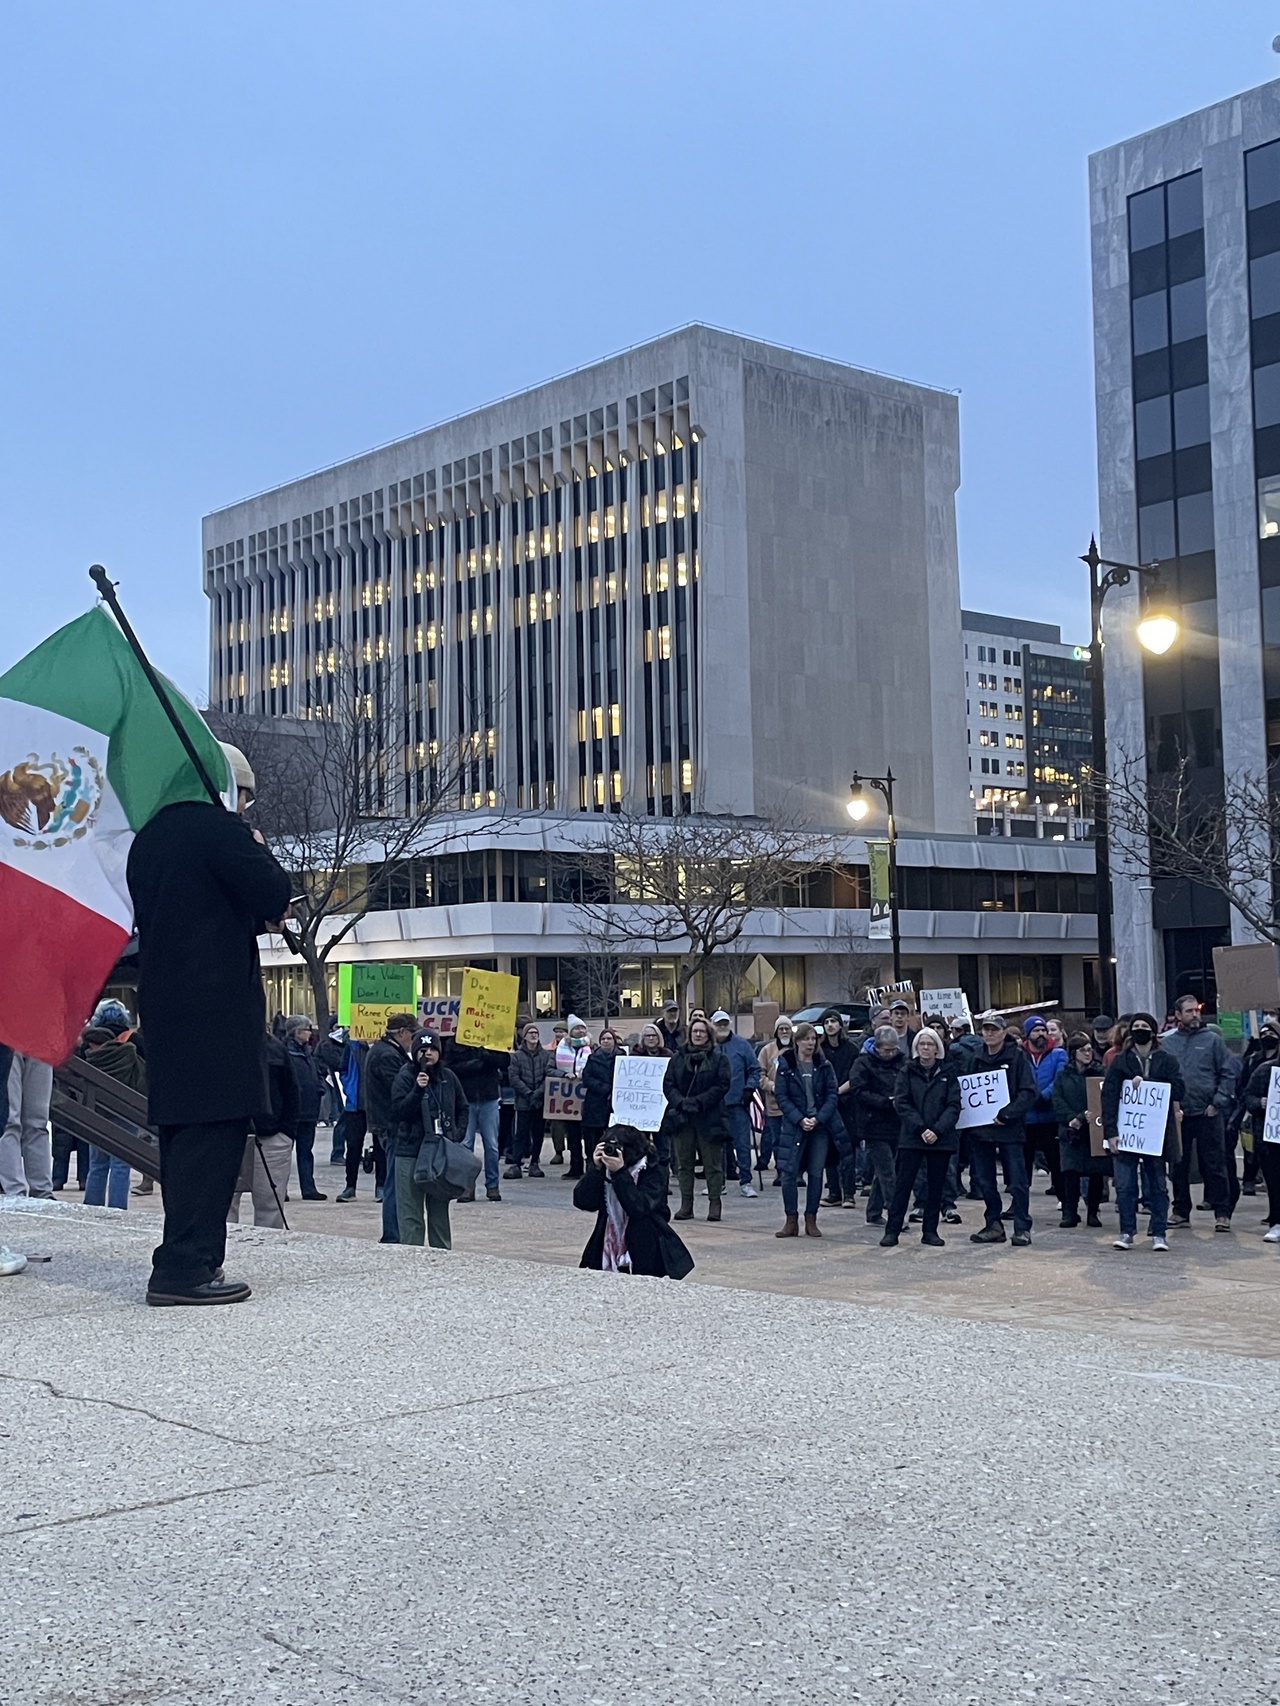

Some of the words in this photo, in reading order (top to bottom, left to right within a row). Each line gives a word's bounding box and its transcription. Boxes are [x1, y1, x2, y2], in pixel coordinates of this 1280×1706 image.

[355, 966, 376, 980] The
[470, 977, 490, 992] Due
[383, 987, 401, 999] Lie
[462, 1029, 490, 1043] Great
[627, 1079, 652, 1089] ICE
[616, 1090, 663, 1106] PROTECT
[960, 1088, 998, 1108] CE
[1123, 1111, 1148, 1130] ICE
[1119, 1133, 1146, 1150] NOW
